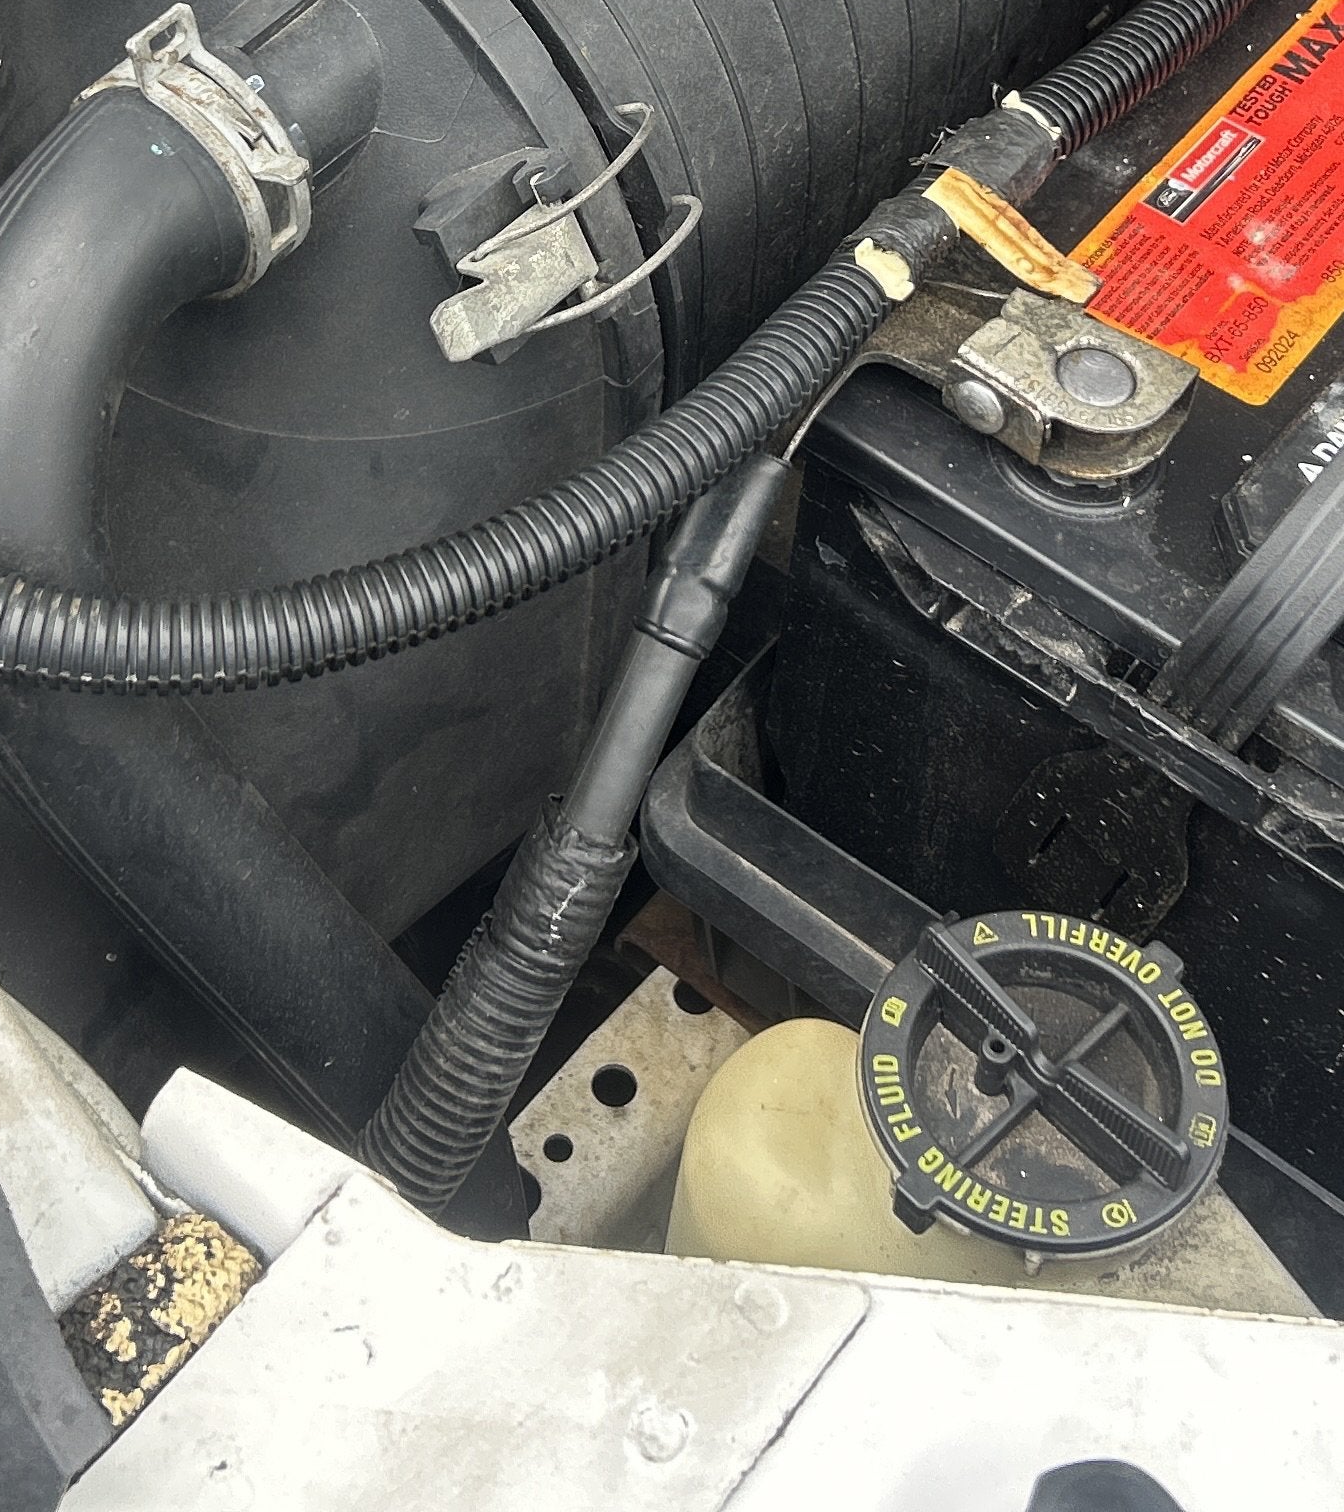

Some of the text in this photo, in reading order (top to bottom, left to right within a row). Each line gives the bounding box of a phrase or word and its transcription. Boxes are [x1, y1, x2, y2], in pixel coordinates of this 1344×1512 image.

[1228, 73, 1278, 119] TESTED
[1179, 127, 1239, 183] Motorcraft
[1285, 113, 1325, 148] Company
[1251, 164, 1277, 185] Ford
[1266, 144, 1295, 169] Motor
[1218, 211, 1256, 246] American
[1245, 193, 1273, 216] Road,
[1292, 132, 1329, 165] Michigan
[1242, 180, 1262, 195] for
[1199, 190, 1253, 242] Manufactured
[1202, 294, 1271, 364] BXT-65-850
[1253, 328, 1302, 374] 092024
[1022, 912, 1222, 1088] DO NOT OVERFILL
[868, 1053, 1071, 1238] STEERING FLUID
